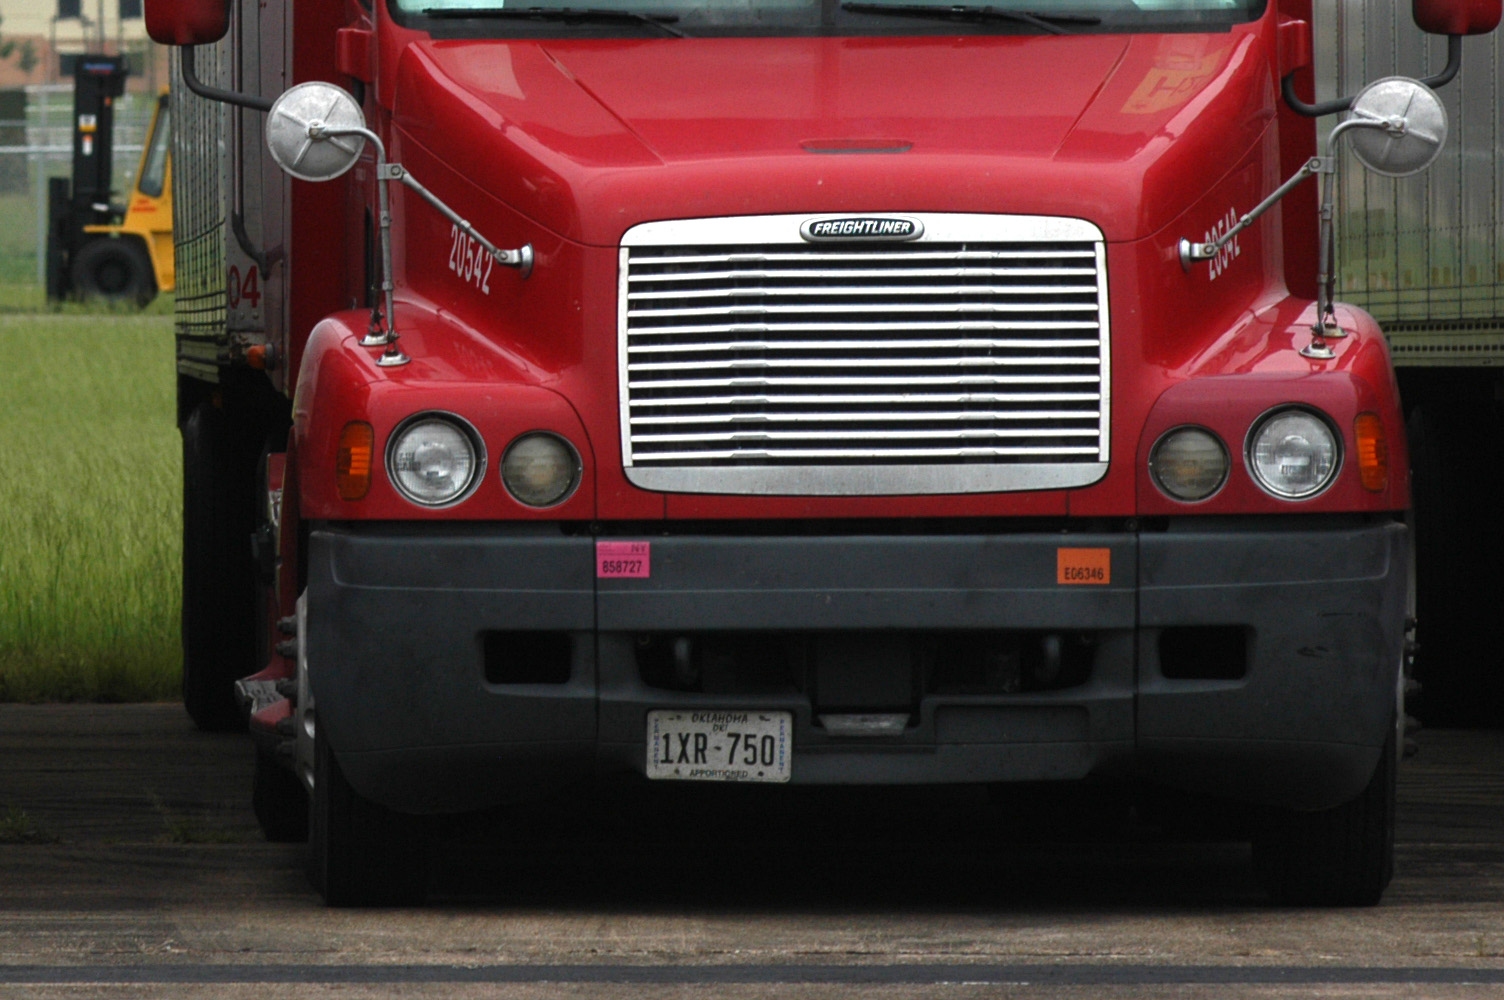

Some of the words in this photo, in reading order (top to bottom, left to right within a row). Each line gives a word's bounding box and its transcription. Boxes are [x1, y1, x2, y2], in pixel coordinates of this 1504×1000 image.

[813, 220, 912, 235] FREIGHTLINER
[448, 223, 494, 296] 20542
[602, 560, 643, 574] 858727
[691, 712, 748, 724] OKLAHOMA
